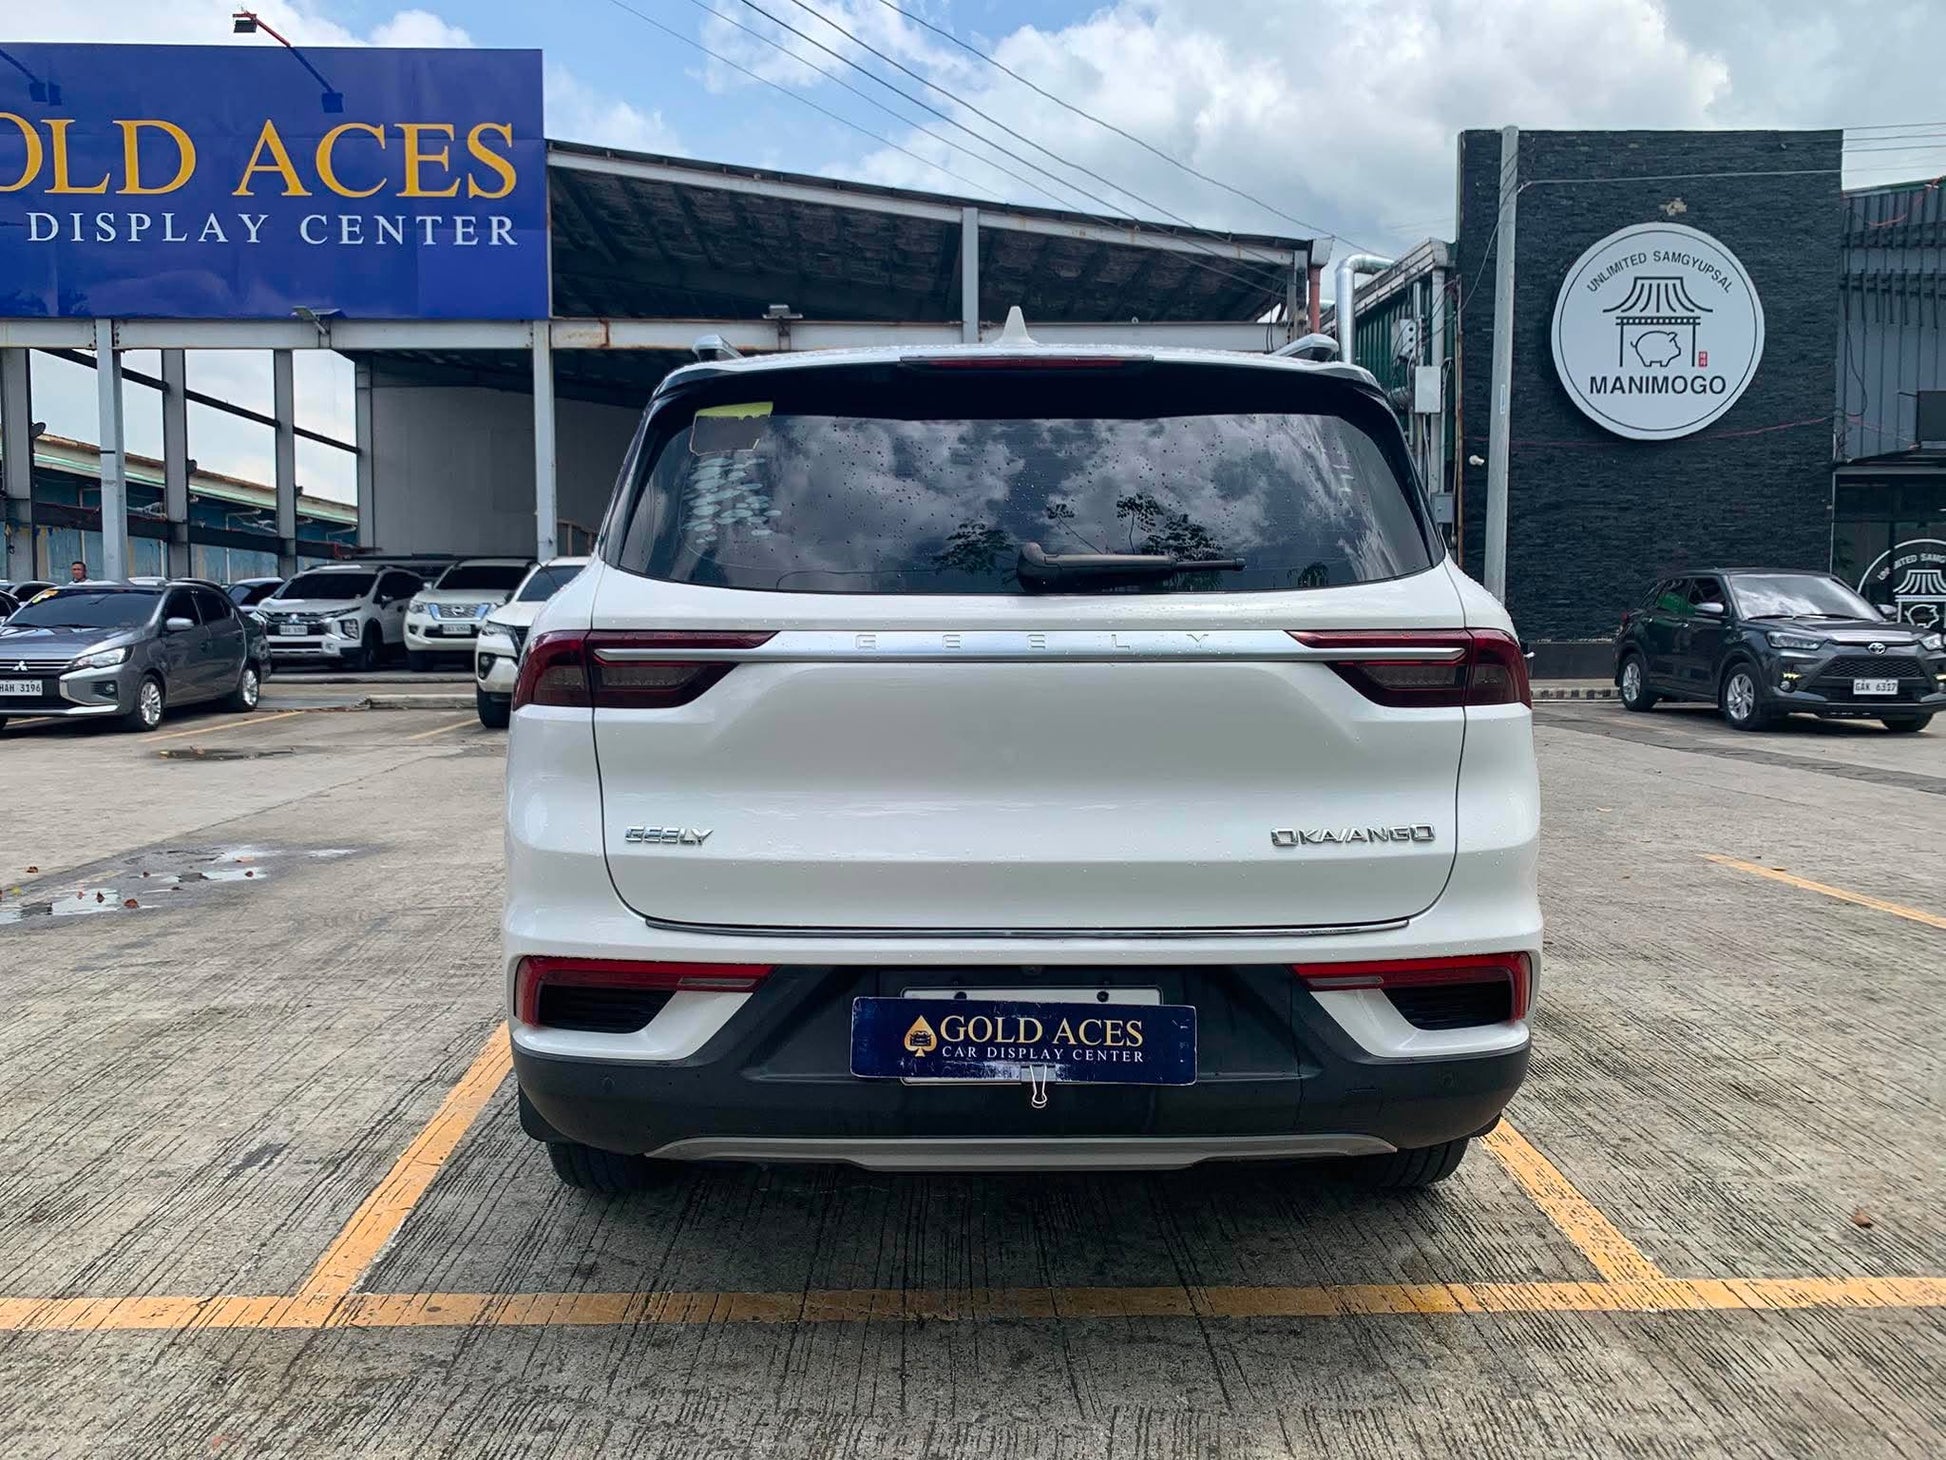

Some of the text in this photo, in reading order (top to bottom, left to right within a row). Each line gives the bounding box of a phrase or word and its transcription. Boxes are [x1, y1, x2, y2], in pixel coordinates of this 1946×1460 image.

[232, 119, 518, 199] ACES
[27, 212, 518, 246] DISPLAY CENTER
[1587, 250, 1734, 294] UNLIMITED SAMGYUPSAL
[1589, 375, 1727, 395] MANIMOGO
[854, 633, 1209, 650] GEELY
[20, 683, 41, 692] 3196
[625, 825, 714, 845] GEELY
[940, 1015, 1144, 1047] GOLD ACES
[942, 1046, 1144, 1063] CAR DISPLAY CENTER
